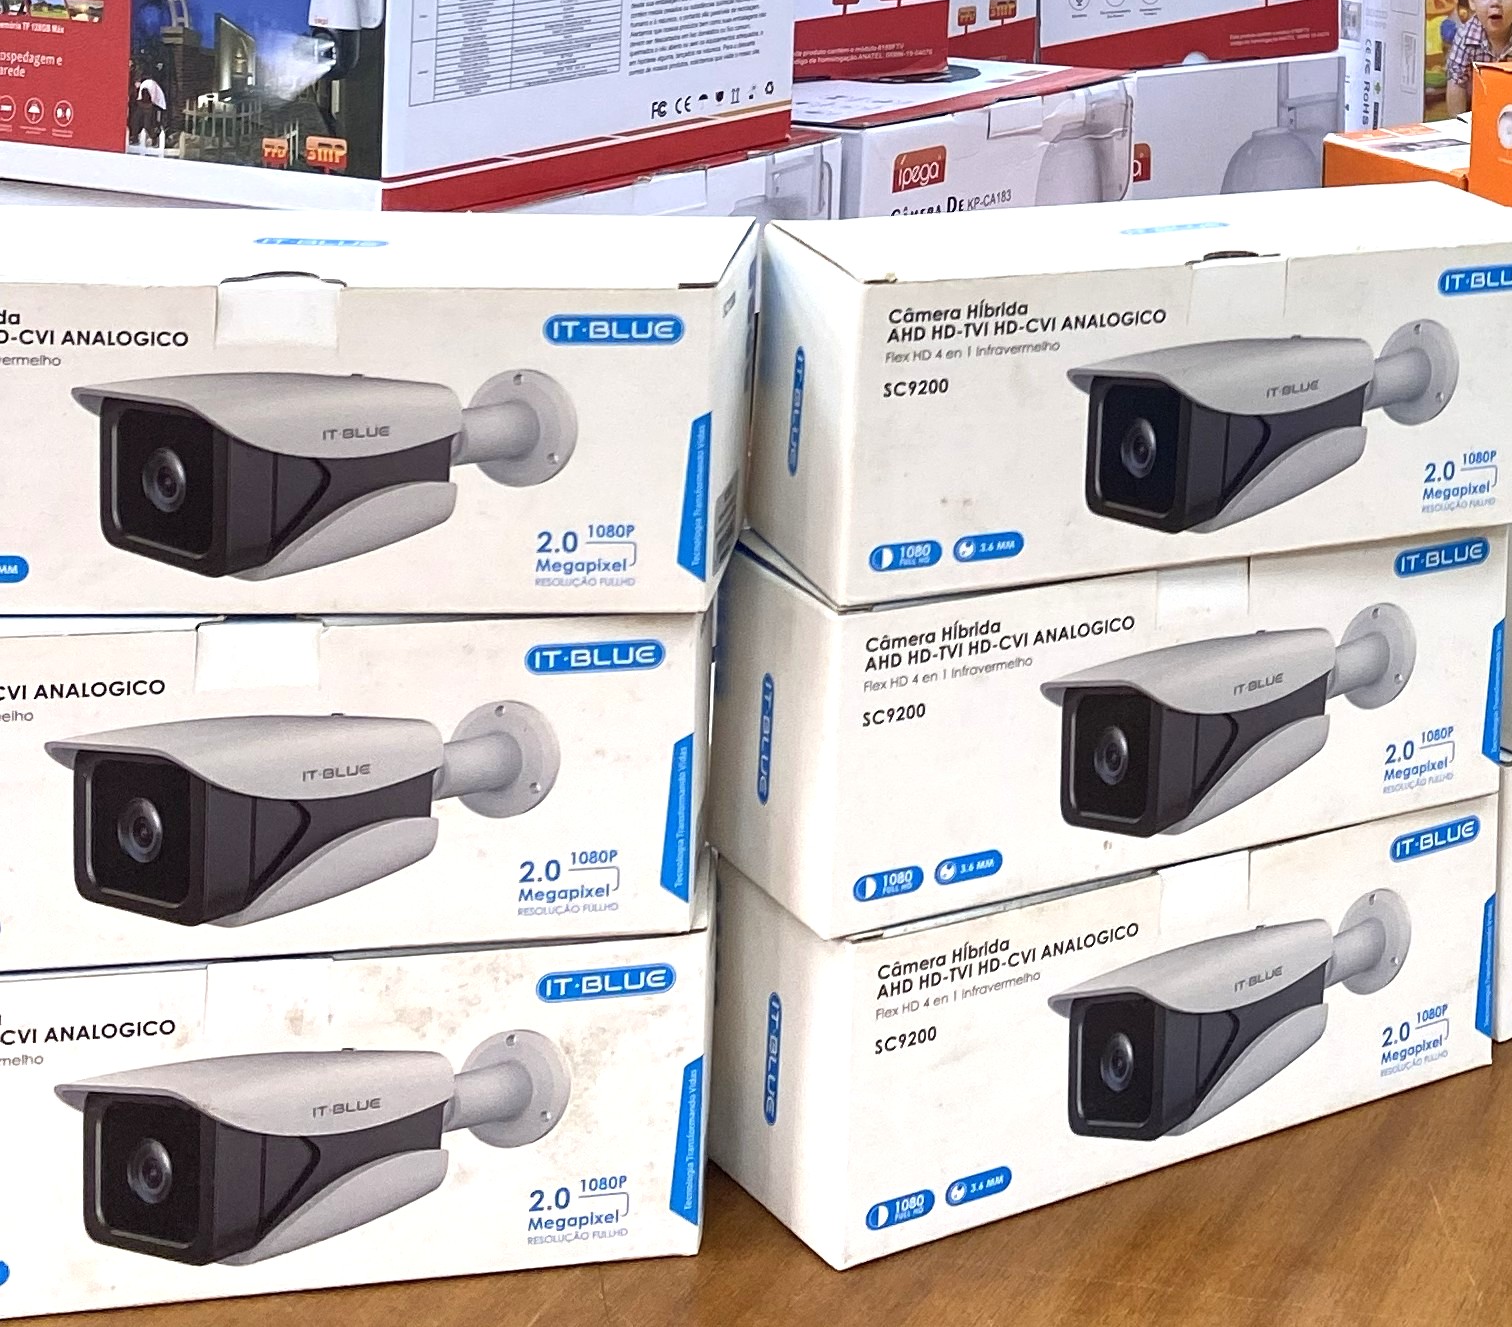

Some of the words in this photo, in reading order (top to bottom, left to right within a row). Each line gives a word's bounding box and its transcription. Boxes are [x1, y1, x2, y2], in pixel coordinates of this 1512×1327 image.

[0, 51, 55, 66] ospedagem
[967, 189, 1012, 211] KP-CA183
[887, 326, 926, 343] AHD
[932, 322, 989, 340] HD-TVI
[994, 318, 1056, 335] HD-CVI
[1062, 309, 1167, 331] ANALOGICO
[888, 307, 961, 324] Câmera
[61, 330, 188, 347] ANALOGICO
[885, 351, 909, 363] Flex
[913, 350, 931, 361] HD
[976, 341, 1060, 356] Infravermelho
[883, 378, 949, 398] SC9200
[1424, 461, 1455, 483] 2.0
[1462, 451, 1497, 465] 1080P
[1423, 480, 1492, 501] Megapixel
[536, 531, 578, 553] 2.0
[588, 524, 634, 538] 1080P
[900, 544, 931, 558] 1080
[535, 558, 627, 574] Megapixel
[865, 630, 936, 652] Câmera
[865, 652, 901, 672] AHD
[908, 644, 963, 665] HD-TVI
[968, 633, 1028, 656] HD-CVI
[1033, 616, 1135, 646] ANALOGICO
[864, 679, 887, 692] Flex
[890, 675, 908, 688] HD
[951, 657, 1033, 679] Infravermelho
[34, 679, 166, 700] ANALOGICO
[862, 703, 926, 727] SC9200
[1385, 740, 1414, 765] 2.0
[1421, 725, 1454, 743] 1080P
[1383, 756, 1448, 782] Megapixel
[519, 859, 561, 883] 2.0
[571, 850, 618, 865] 1080P
[884, 870, 913, 886] 1080
[518, 884, 610, 903] Megapixel
[518, 904, 580, 916] RESOLUÇÃO
[877, 978, 913, 1000] AHD
[919, 964, 973, 991] HD-TVI
[978, 948, 1036, 974] HD-CVI
[1041, 922, 1139, 959] ANALOGICO
[878, 954, 946, 980] Câmera
[875, 1007, 898, 1020] Flex
[902, 1000, 919, 1013] HD
[961, 972, 1041, 999] Infravermelho
[44, 1018, 176, 1043] ANALOGICO
[1382, 1021, 1410, 1047] 2.0
[1417, 1003, 1448, 1023] 1080P
[875, 1026, 937, 1055] SC9200
[1381, 1034, 1442, 1065] Megapixel
[528, 1187, 570, 1212] 2.0
[580, 1175, 627, 1192] 1080P
[896, 1194, 924, 1211] 1080
[528, 1210, 619, 1231] Megapixel
[528, 1231, 589, 1245] RESOLUÇÃO
